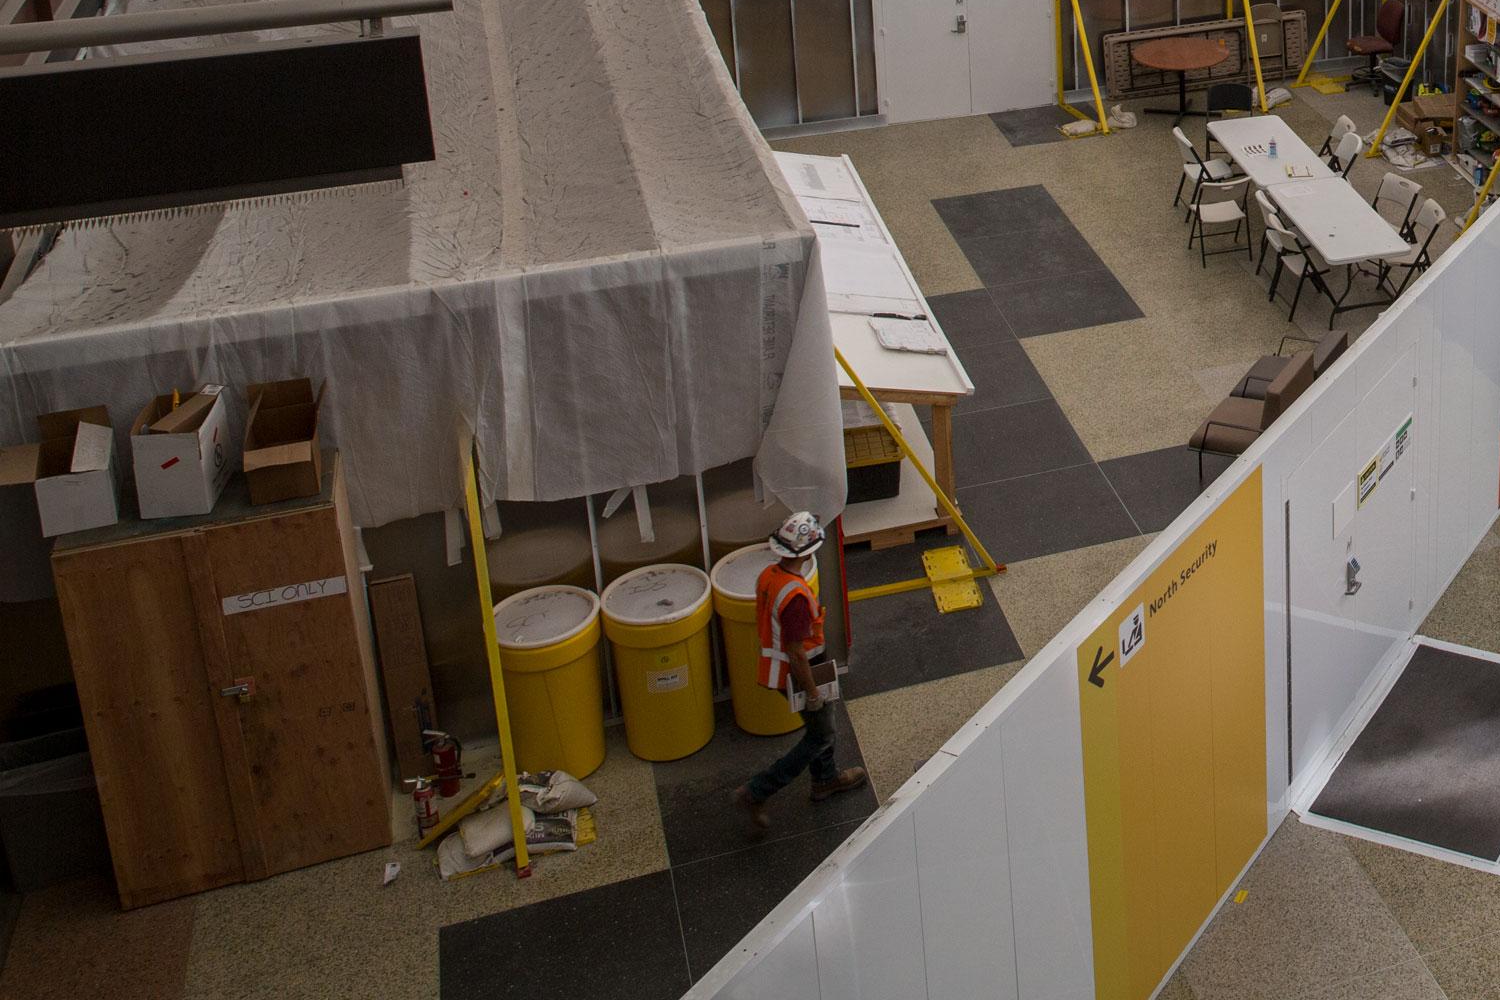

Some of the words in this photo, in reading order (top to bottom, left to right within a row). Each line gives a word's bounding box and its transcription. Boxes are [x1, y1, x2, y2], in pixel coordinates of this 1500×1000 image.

[237, 588, 277, 609] SCI
[1149, 579, 1178, 618] North
[1180, 539, 1218, 586] Security
